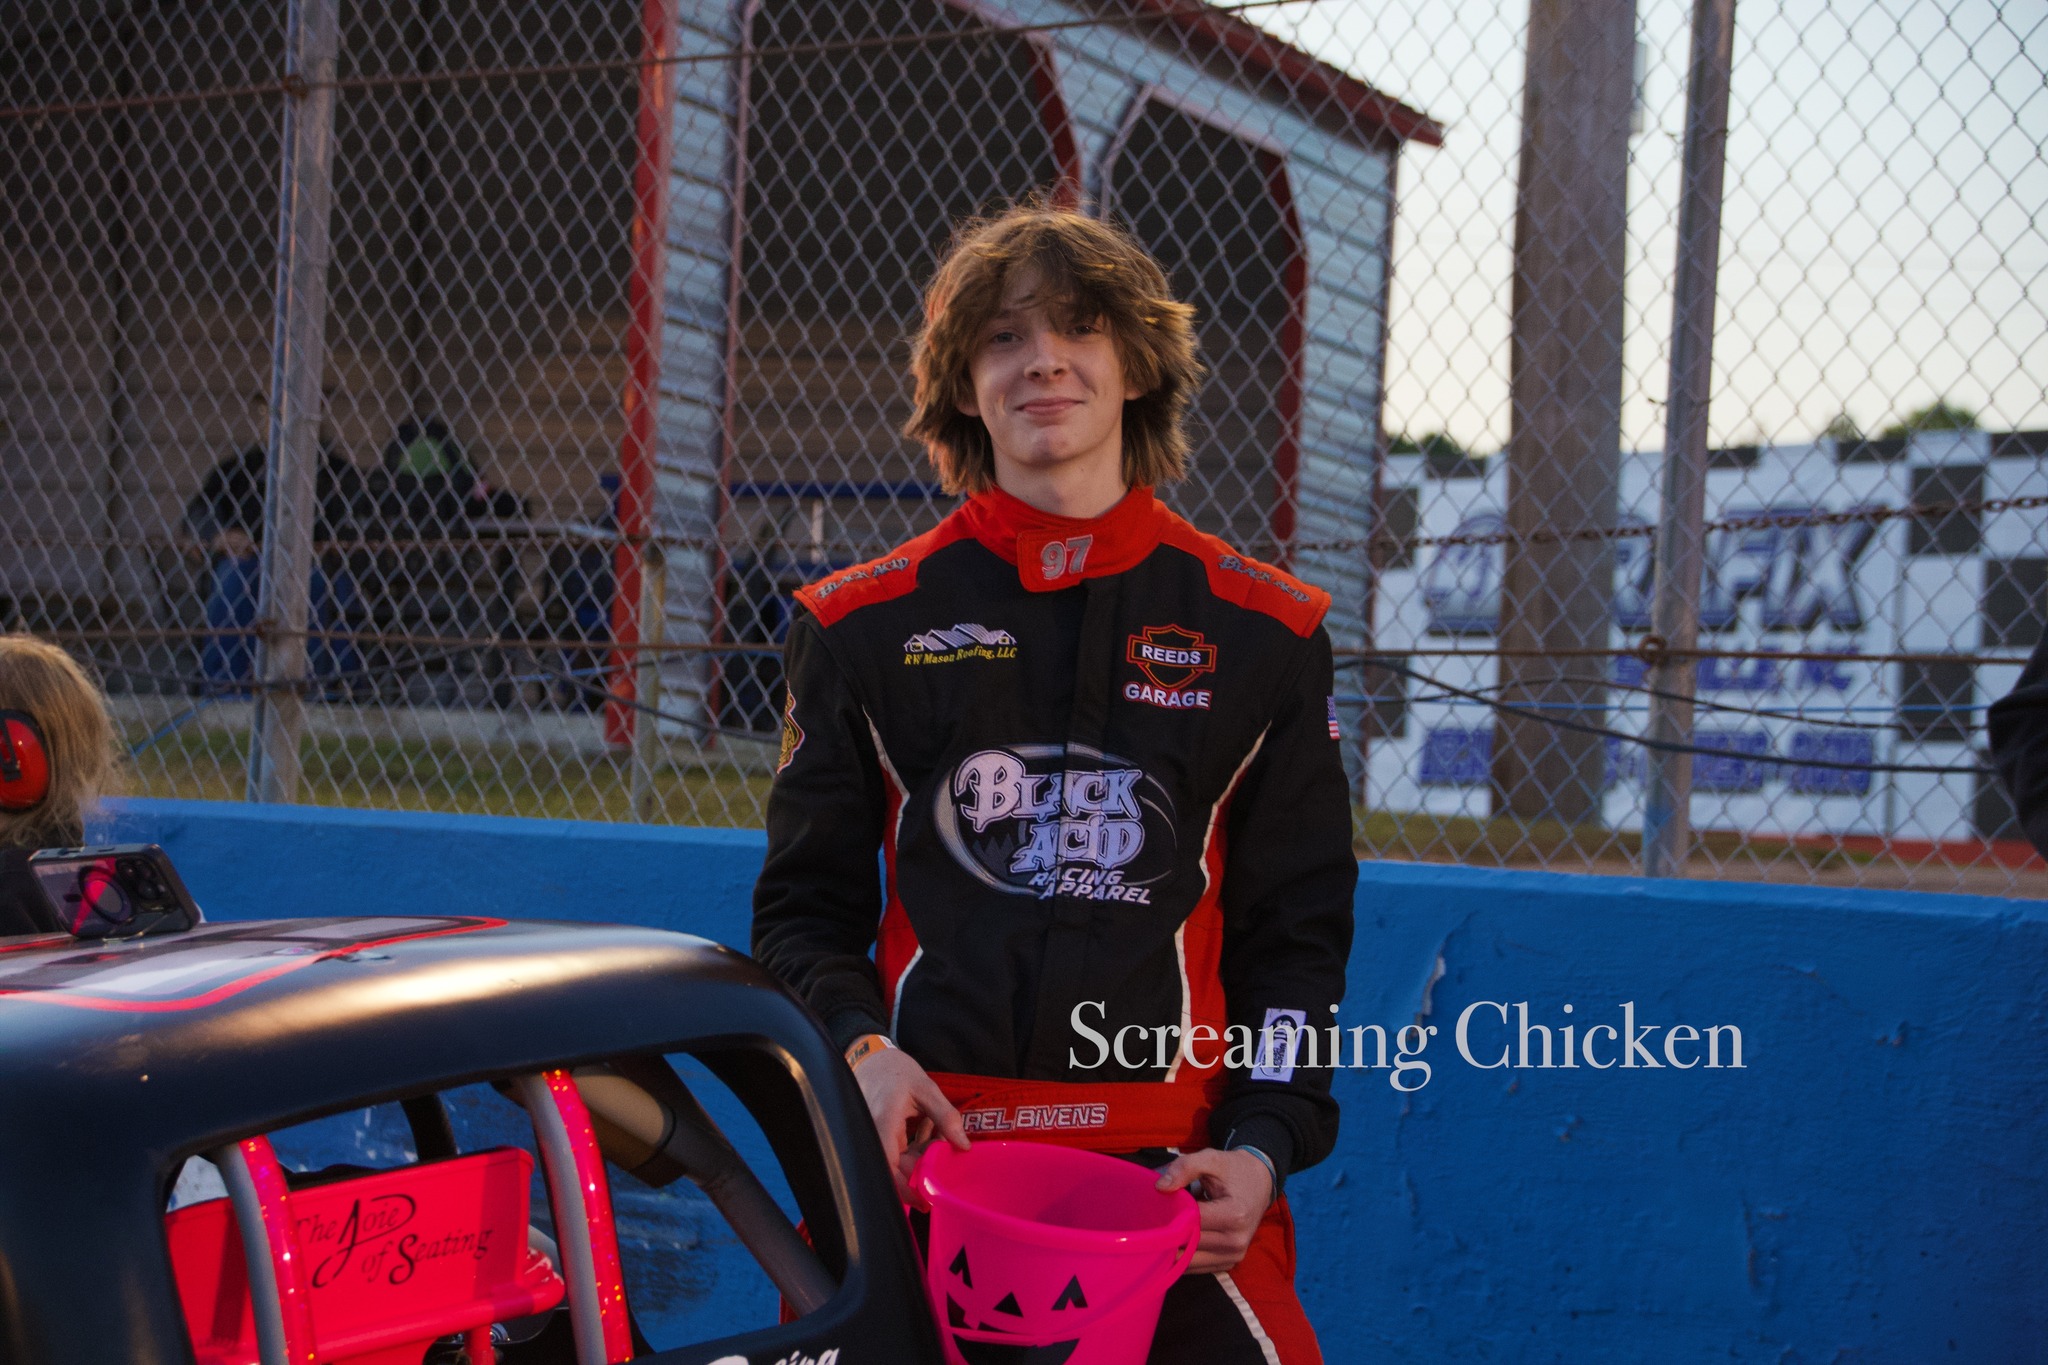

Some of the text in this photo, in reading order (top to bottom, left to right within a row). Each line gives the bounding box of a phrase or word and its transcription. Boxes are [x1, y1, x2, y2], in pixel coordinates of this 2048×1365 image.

[1041, 534, 1093, 580] 97
[923, 652, 955, 665] Mason
[956, 645, 995, 661] Roofing,
[996, 646, 1018, 658] LLC
[1141, 644, 1202, 665] REEDS
[1124, 682, 1211, 708] GARAGE
[955, 750, 1142, 833] BLACK
[1010, 810, 1146, 873] ACID
[1028, 867, 1125, 888] RACING
[1038, 880, 1151, 905] APPAREL
[361, 1229, 493, 1285] of Seating
